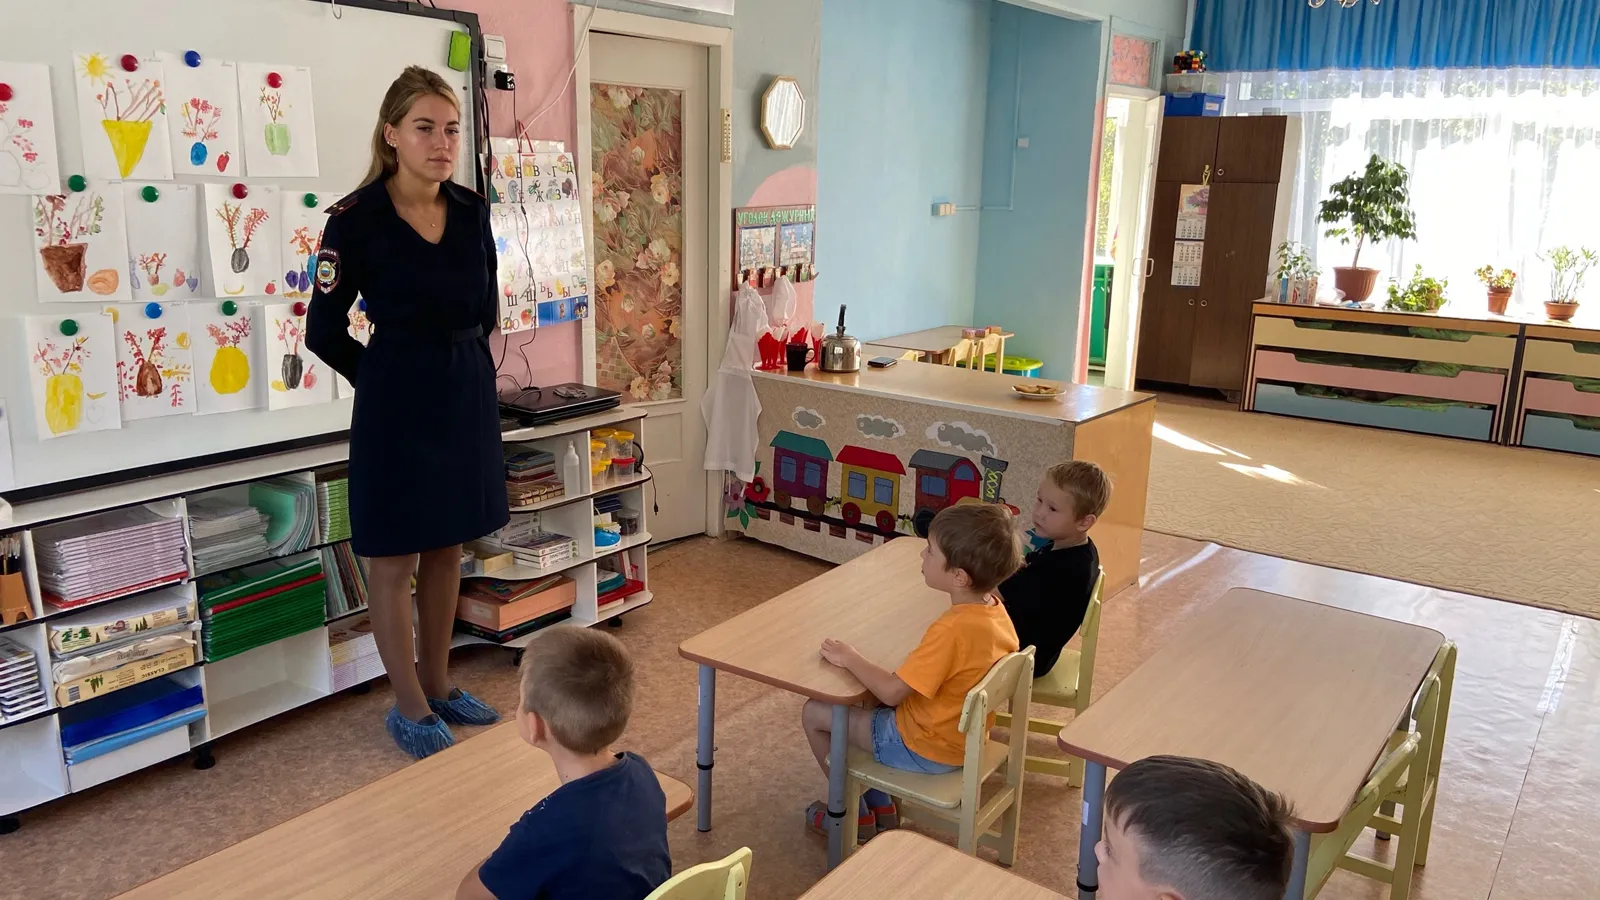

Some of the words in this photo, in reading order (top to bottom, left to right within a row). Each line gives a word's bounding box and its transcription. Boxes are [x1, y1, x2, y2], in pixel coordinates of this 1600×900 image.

[496, 167, 503, 179] А
[533, 166, 540, 176] В
[552, 166, 558, 177] Г
[566, 162, 574, 175] Д
[498, 192, 505, 203] Е
[535, 190, 544, 202] Ж
[555, 189, 561, 200] З
[507, 295, 518, 306] Ш
[563, 286, 571, 297] Ы
